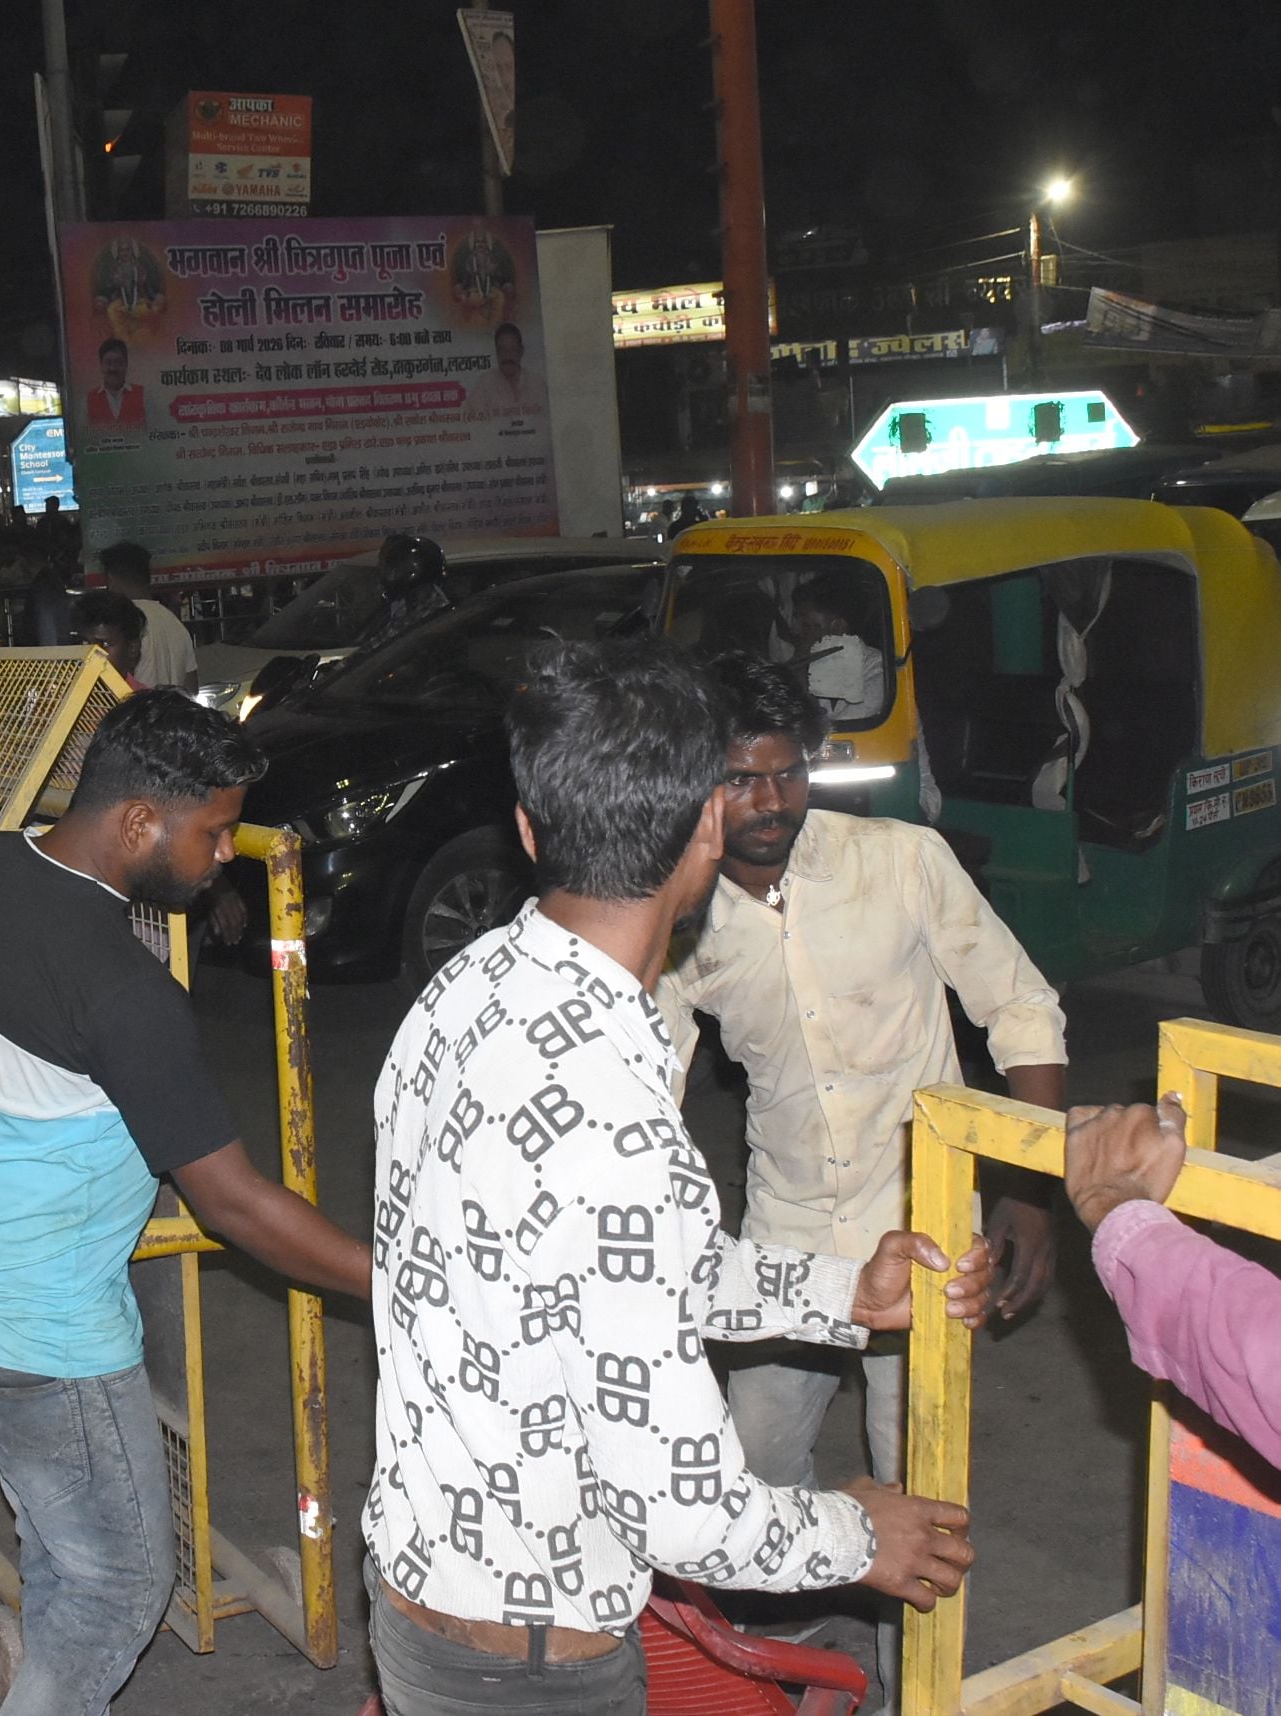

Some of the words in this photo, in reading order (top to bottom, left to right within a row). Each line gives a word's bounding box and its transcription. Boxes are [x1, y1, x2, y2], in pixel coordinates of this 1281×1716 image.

[229, 114, 303, 127] MECHANIC
[235, 184, 280, 196] YAMAHA
[205, 204, 227, 215] +91
[167, 246, 247, 277] भगवान
[253, 237, 281, 275] श्री
[285, 235, 366, 282] चित्रगुप्त
[370, 243, 412, 281] पूजा
[416, 234, 447, 273] एवं
[200, 286, 257, 329] होली
[264, 285, 332, 326] मिलन
[339, 286, 423, 323] समारोह
[257, 337, 283, 352] 2026
[275, 360, 303, 380] लोक
[46, 428, 64, 438] CM
[19, 443, 36, 452] City
[20, 450, 66, 460] Montessor
[20, 459, 49, 469] School
